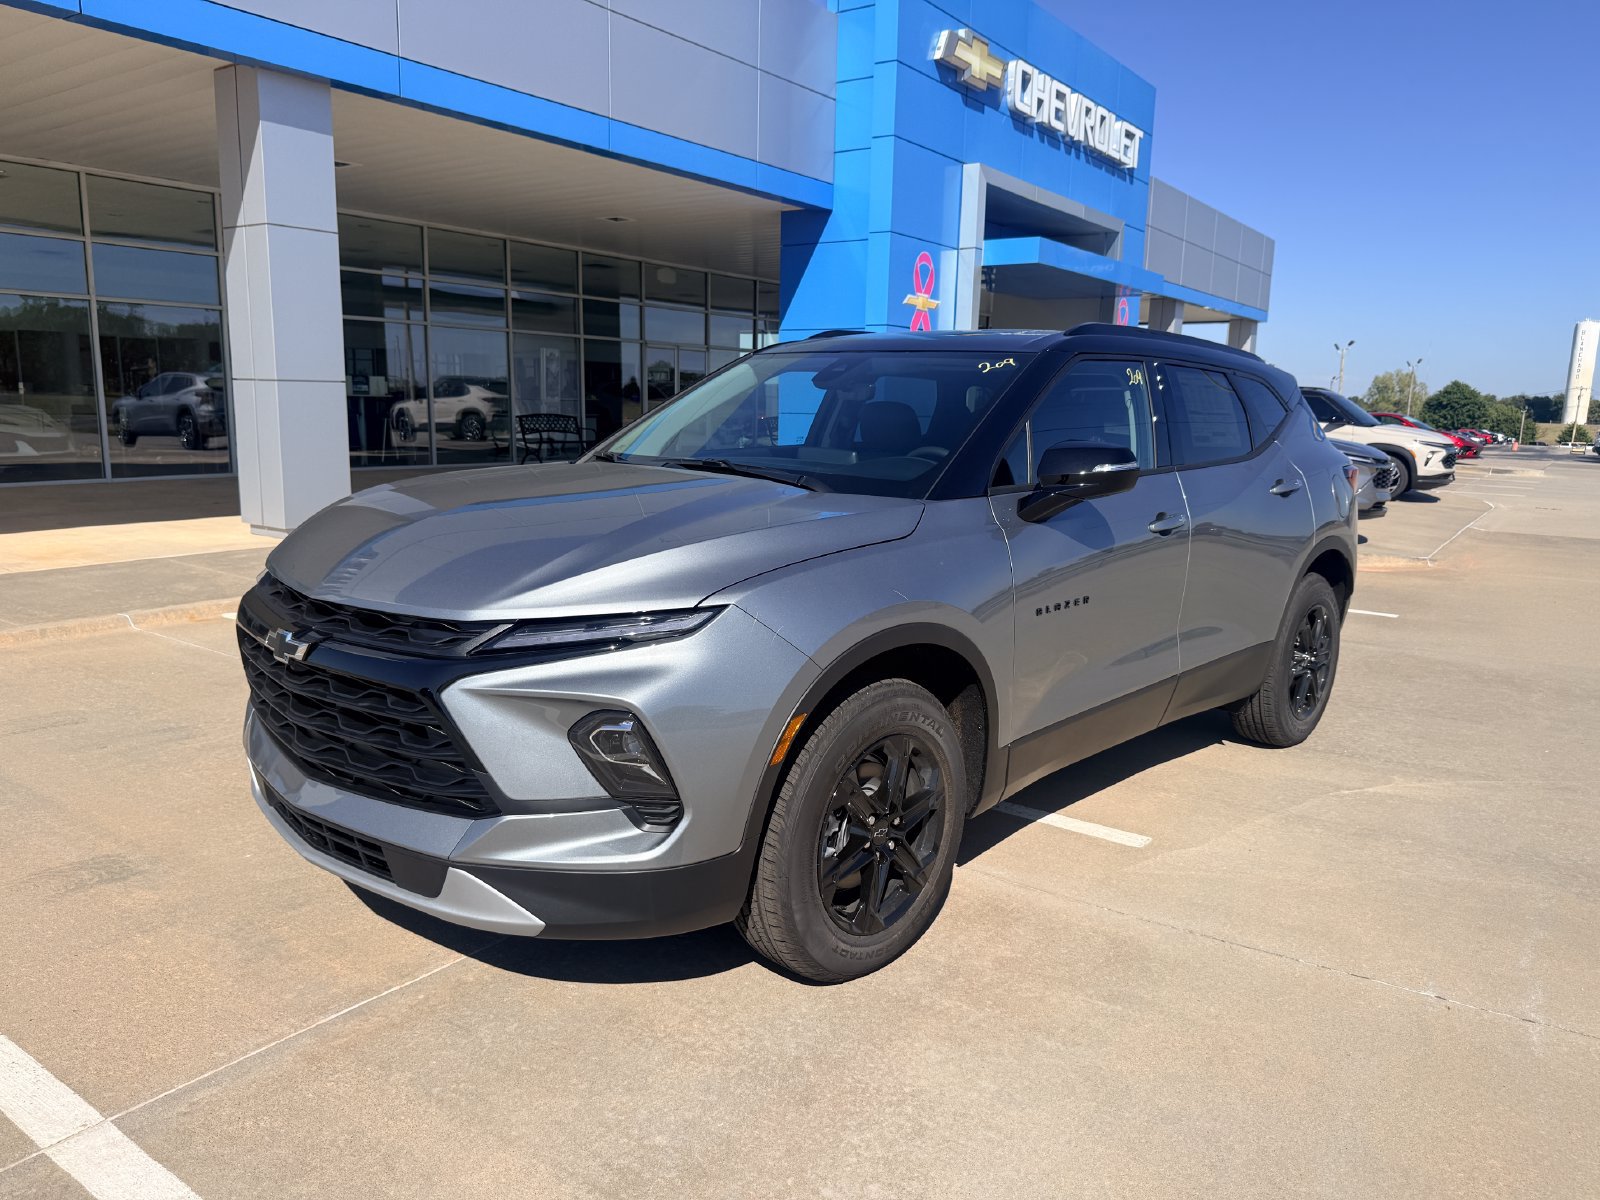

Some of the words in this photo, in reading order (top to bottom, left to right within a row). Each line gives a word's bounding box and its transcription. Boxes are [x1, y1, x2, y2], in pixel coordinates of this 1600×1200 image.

[1007, 59, 1143, 170] CHEVROLET
[978, 358, 1016, 373] 209
[1126, 367, 1143, 386] 209
[1035, 595, 1090, 617] BLAZER
